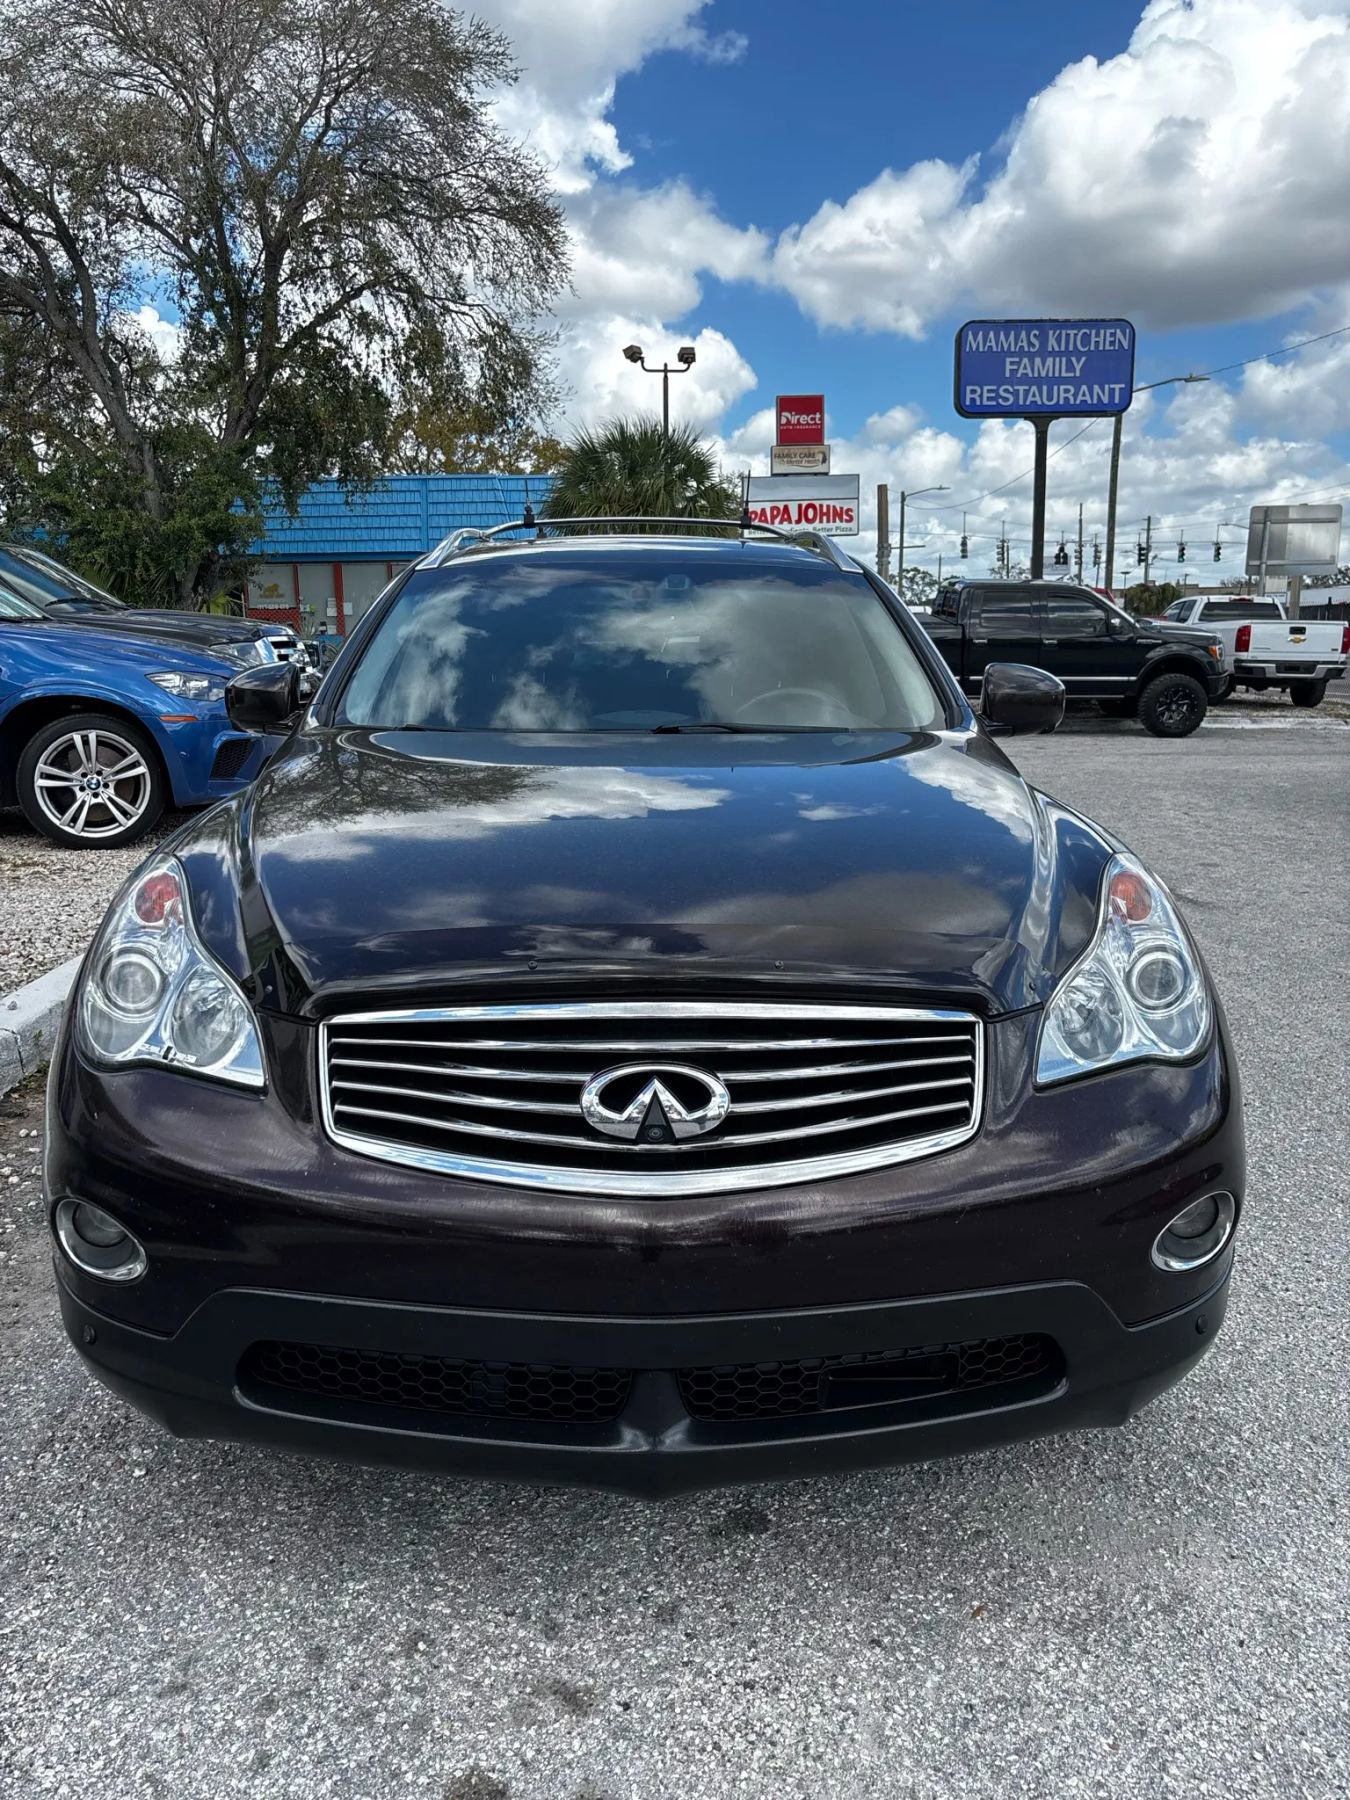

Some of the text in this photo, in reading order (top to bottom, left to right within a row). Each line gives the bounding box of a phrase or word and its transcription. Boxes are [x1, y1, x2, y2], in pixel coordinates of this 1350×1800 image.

[966, 328, 1130, 353] MAMAS KITCHEN
[1004, 356, 1087, 378] FAMILY
[966, 384, 1125, 406] RESTAURANT
[781, 412, 821, 424] Direct
[749, 502, 854, 525] PAPA JOHNS
